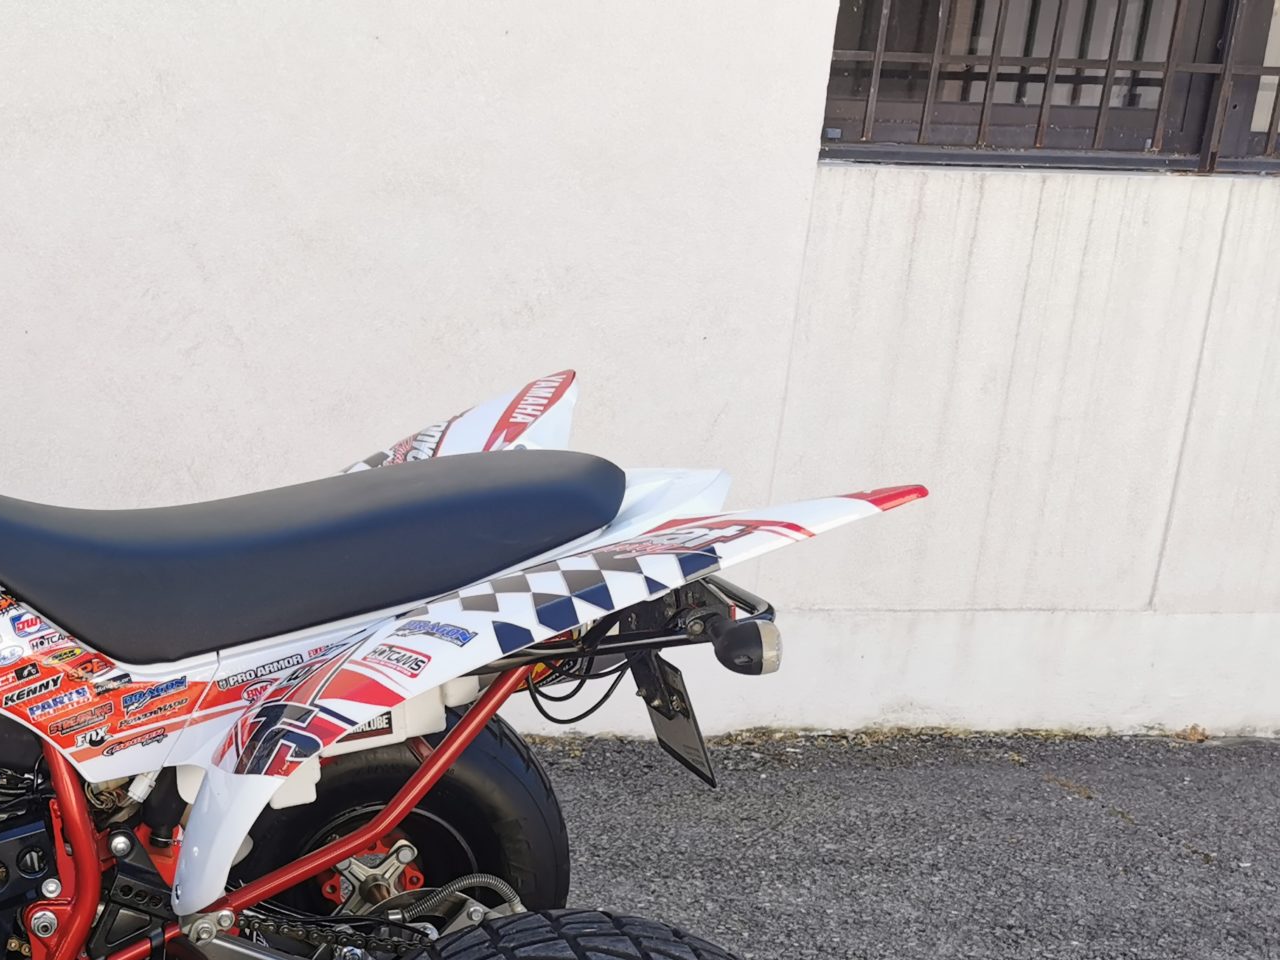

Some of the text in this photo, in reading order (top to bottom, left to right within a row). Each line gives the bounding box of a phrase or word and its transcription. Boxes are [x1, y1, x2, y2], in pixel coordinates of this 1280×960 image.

[509, 375, 566, 423] YAMAHA
[229, 655, 302, 686] PRO ARMOR
[4, 675, 61, 706] KENNY
[28, 687, 88, 717] PARTS
[76, 724, 111, 748] FOX
